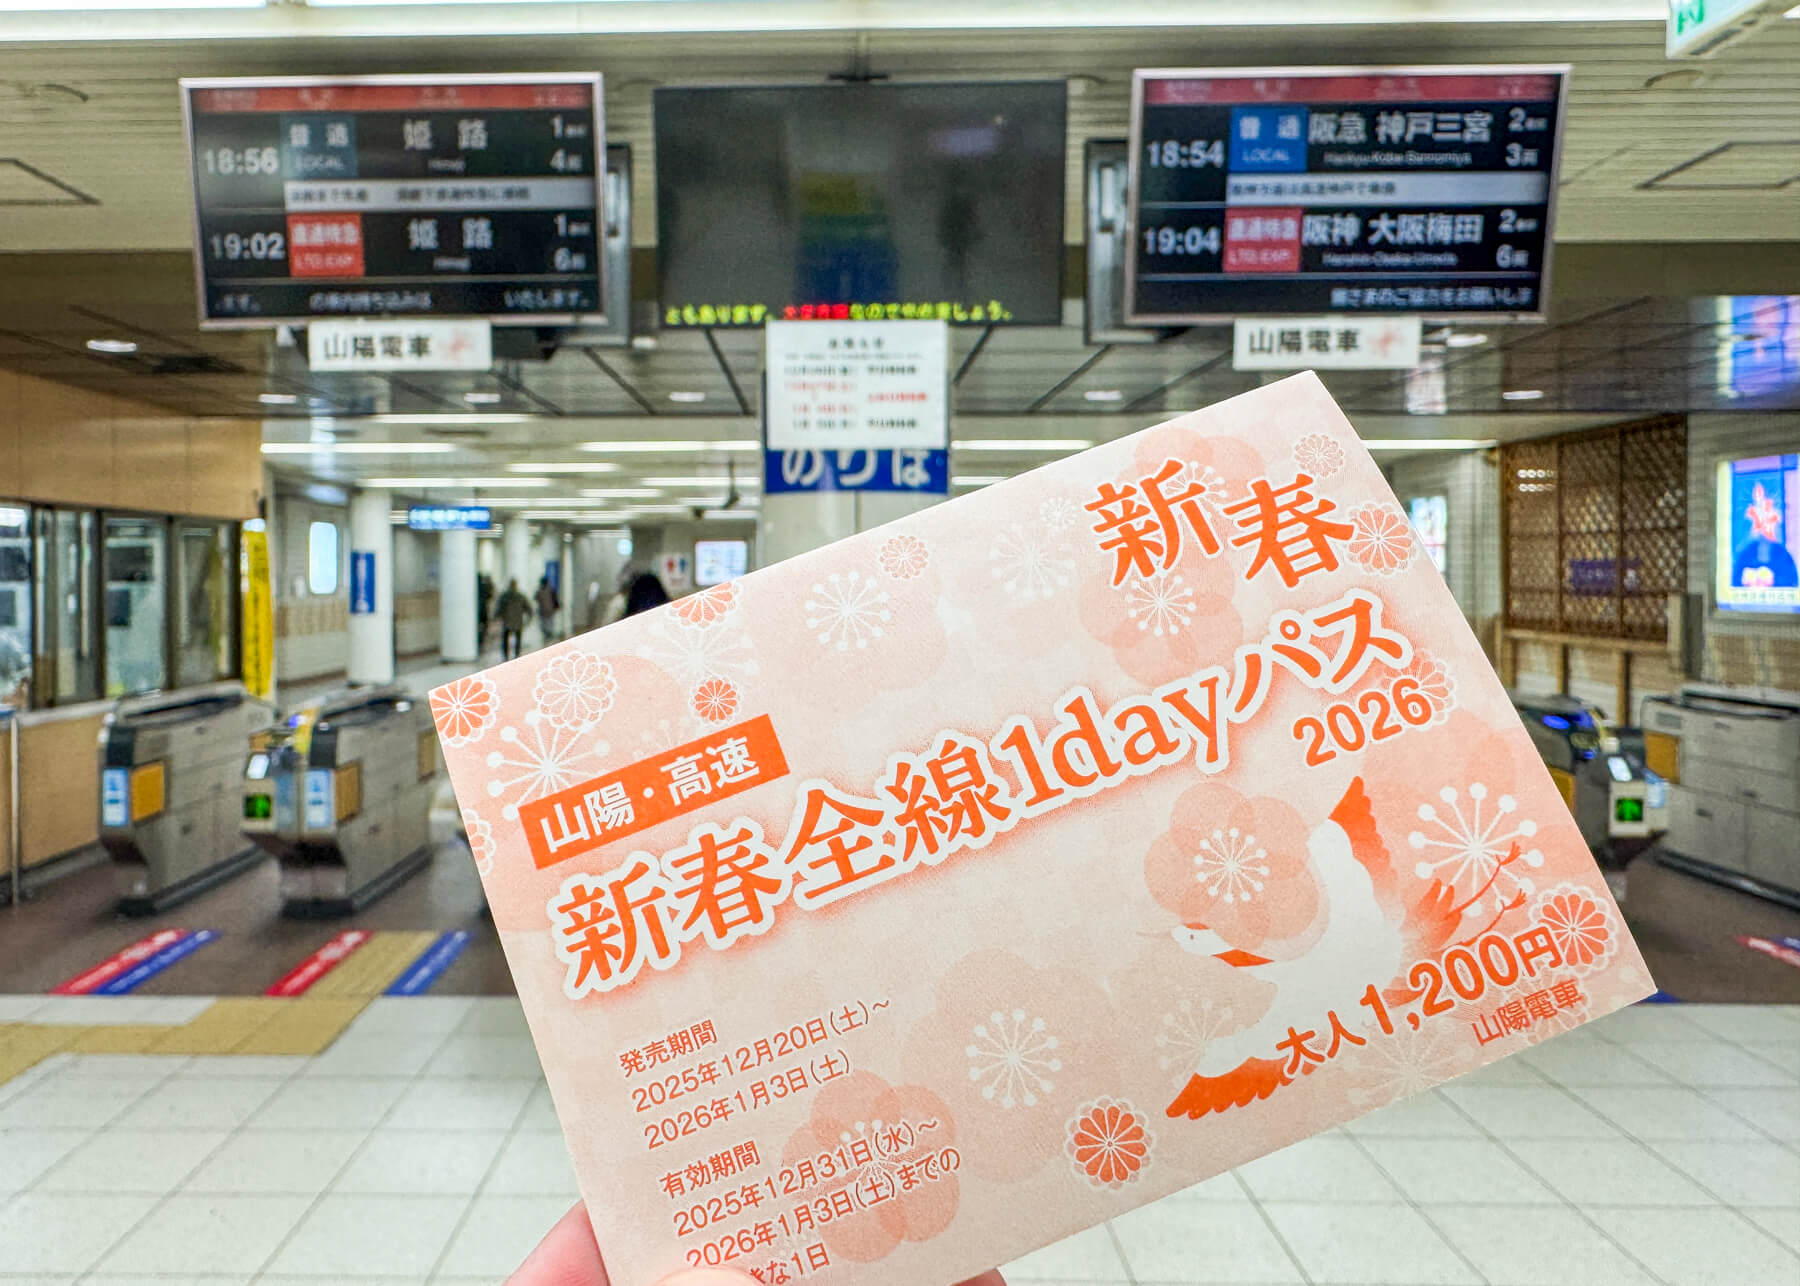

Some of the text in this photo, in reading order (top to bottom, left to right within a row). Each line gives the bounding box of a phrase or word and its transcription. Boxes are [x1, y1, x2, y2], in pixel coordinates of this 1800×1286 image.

[1147, 139, 1225, 168] 18:54
[1308, 111, 1368, 145] 阪急
[1375, 110, 1494, 145] 神戸三宮
[210, 231, 286, 261] 19:02
[1143, 226, 1221, 256] 19:04
[1302, 212, 1362, 247] 阪神
[1367, 212, 1484, 246] 大阪梅田
[323, 332, 432, 359] 山陽電車
[1249, 327, 1360, 355] 山陽電車
[1083, 458, 1355, 589] 新春
[1292, 678, 1433, 768] 2026
[539, 736, 761, 854] 山陽・高速
[556, 597, 1404, 990] 新春全線1dayパス
[1275, 924, 1564, 1076] 大人 1,200円
[1471, 978, 1587, 1048] 山陽電車
[618, 1018, 719, 1078] 発売期間
[644, 1049, 852, 1151] 2026年1月3日(土)
[658, 1139, 762, 1200] 有効期間
[684, 1146, 962, 1268] 2026年1月3日(土)までの
